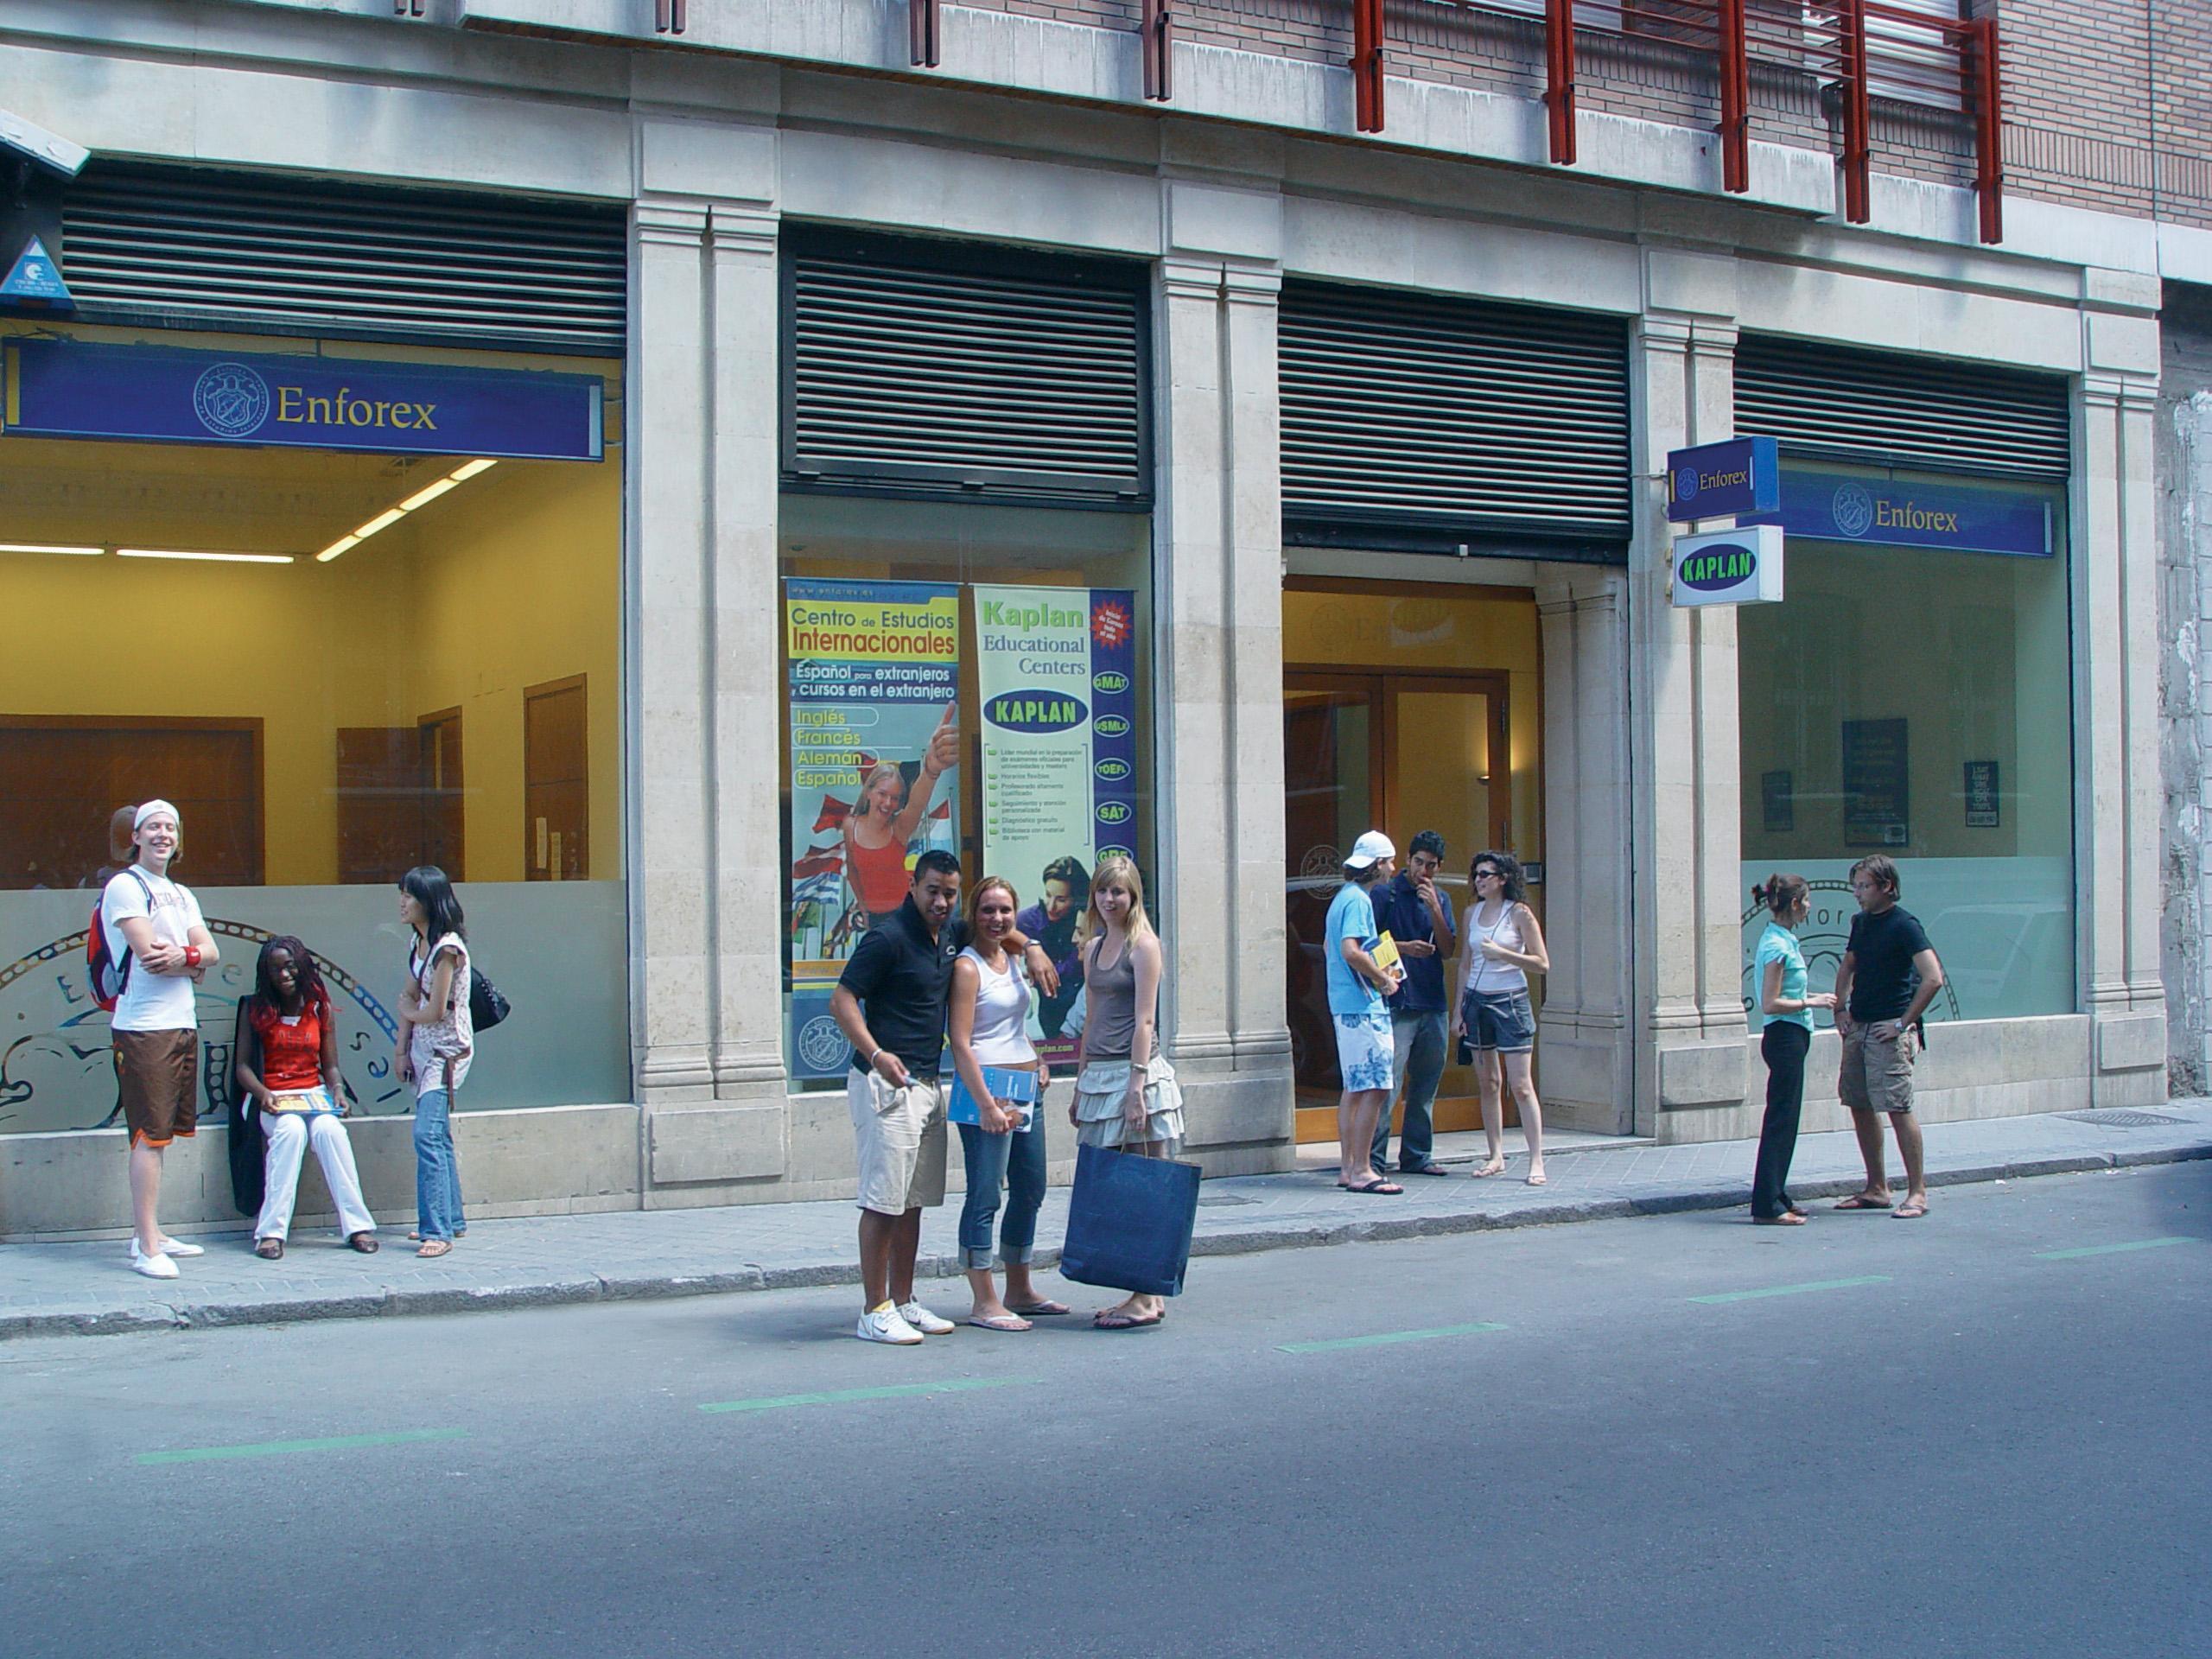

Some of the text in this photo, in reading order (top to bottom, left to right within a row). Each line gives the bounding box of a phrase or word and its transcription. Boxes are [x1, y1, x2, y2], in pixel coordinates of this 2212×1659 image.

[276, 386, 437, 430] Enforex
[1700, 469, 1747, 491] Enforex
[1876, 500, 1958, 532] Enforex
[1683, 552, 1751, 582] KAPLAN
[791, 607, 955, 630] Centro de Estudios
[983, 601, 1084, 632] Kaplan
[792, 627, 955, 655] Internacionales
[983, 635, 1085, 653] Educational
[796, 664, 851, 681] Español
[874, 666, 950, 683] extranjeros
[1019, 658, 1086, 675] Centers
[1094, 676, 1126, 689] GMAT
[799, 684, 845, 696] cursos
[849, 685, 867, 697] en
[870, 683, 883, 698] el
[887, 684, 955, 701] extranjero
[797, 709, 846, 727] Inglés
[995, 700, 1076, 723] KAPLAN
[797, 728, 861, 746] Francés
[798, 748, 862, 766] Alemán
[1098, 763, 1127, 775] TOEFL
[798, 770, 861, 788] Español
[1100, 805, 1125, 820] SAT
